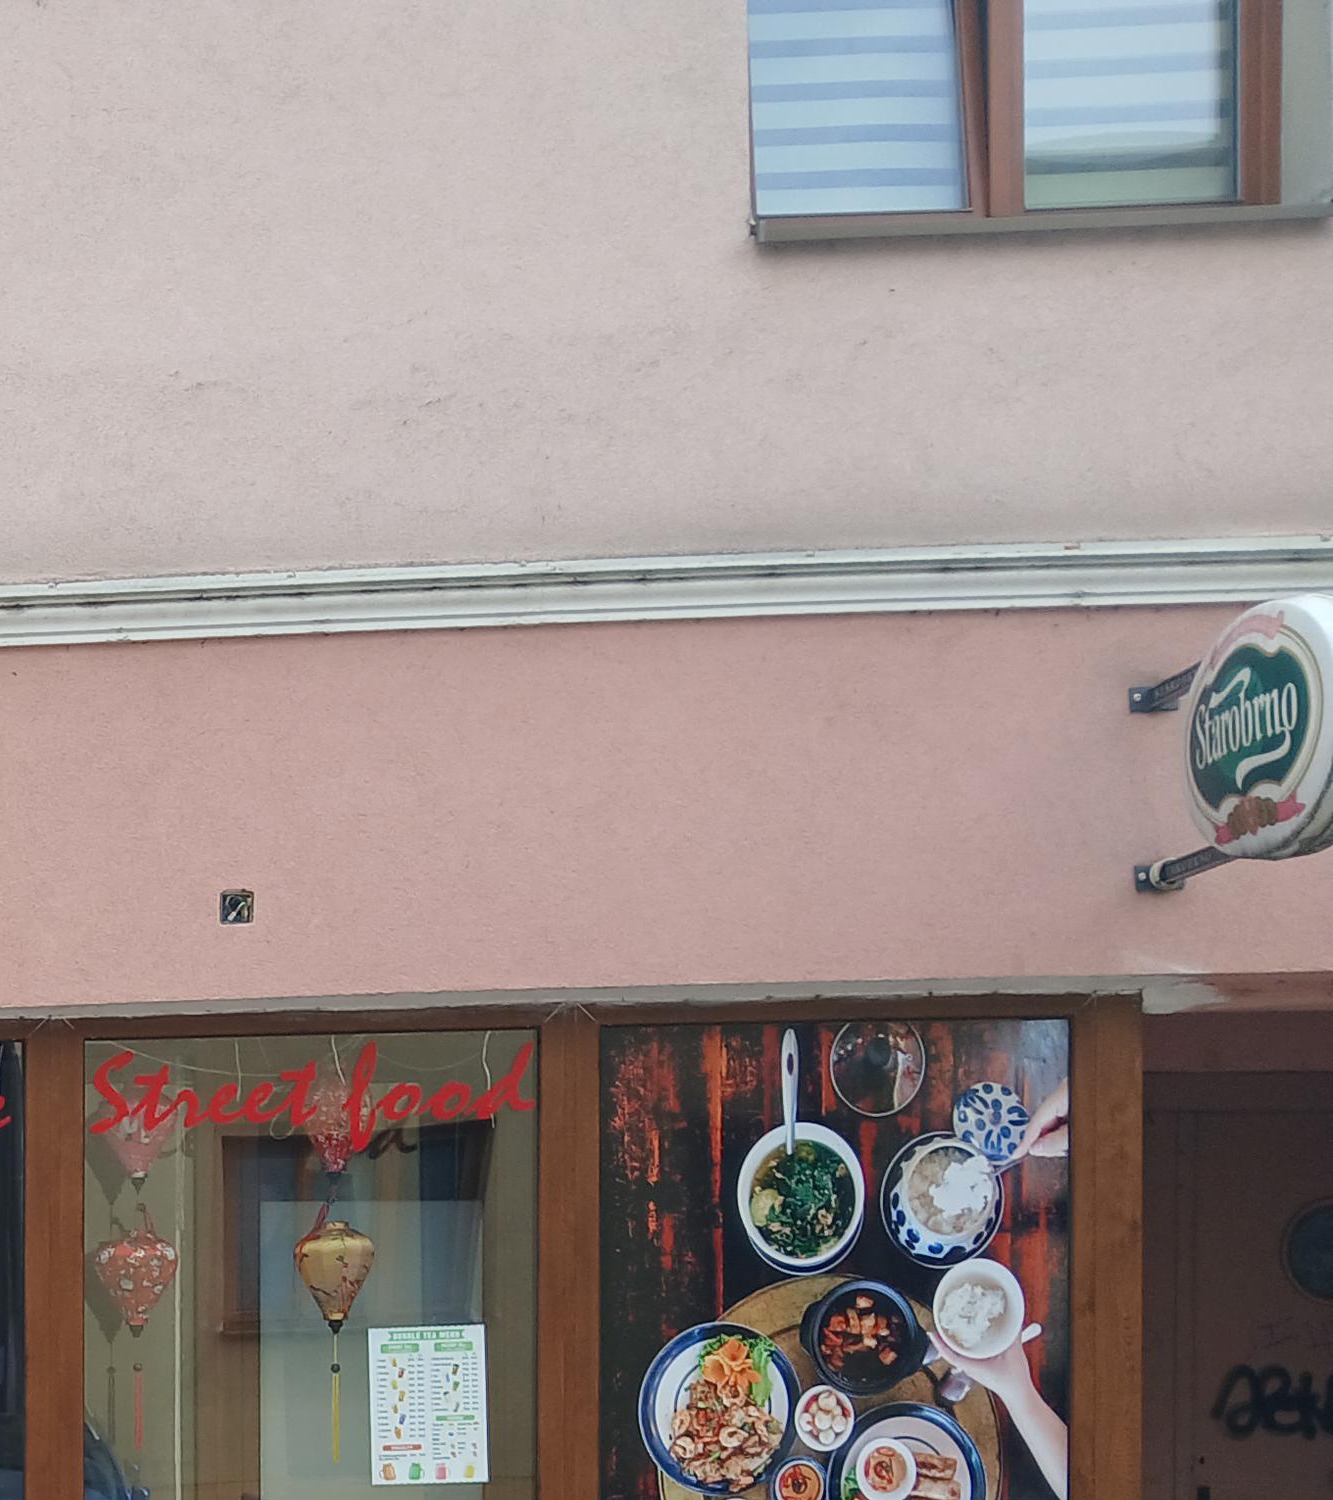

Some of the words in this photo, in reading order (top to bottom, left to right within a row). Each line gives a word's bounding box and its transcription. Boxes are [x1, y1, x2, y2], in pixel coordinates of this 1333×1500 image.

[1195, 667, 1299, 790] Starobrno
[89, 1051, 318, 1135] Street
[341, 1040, 537, 1153] food
